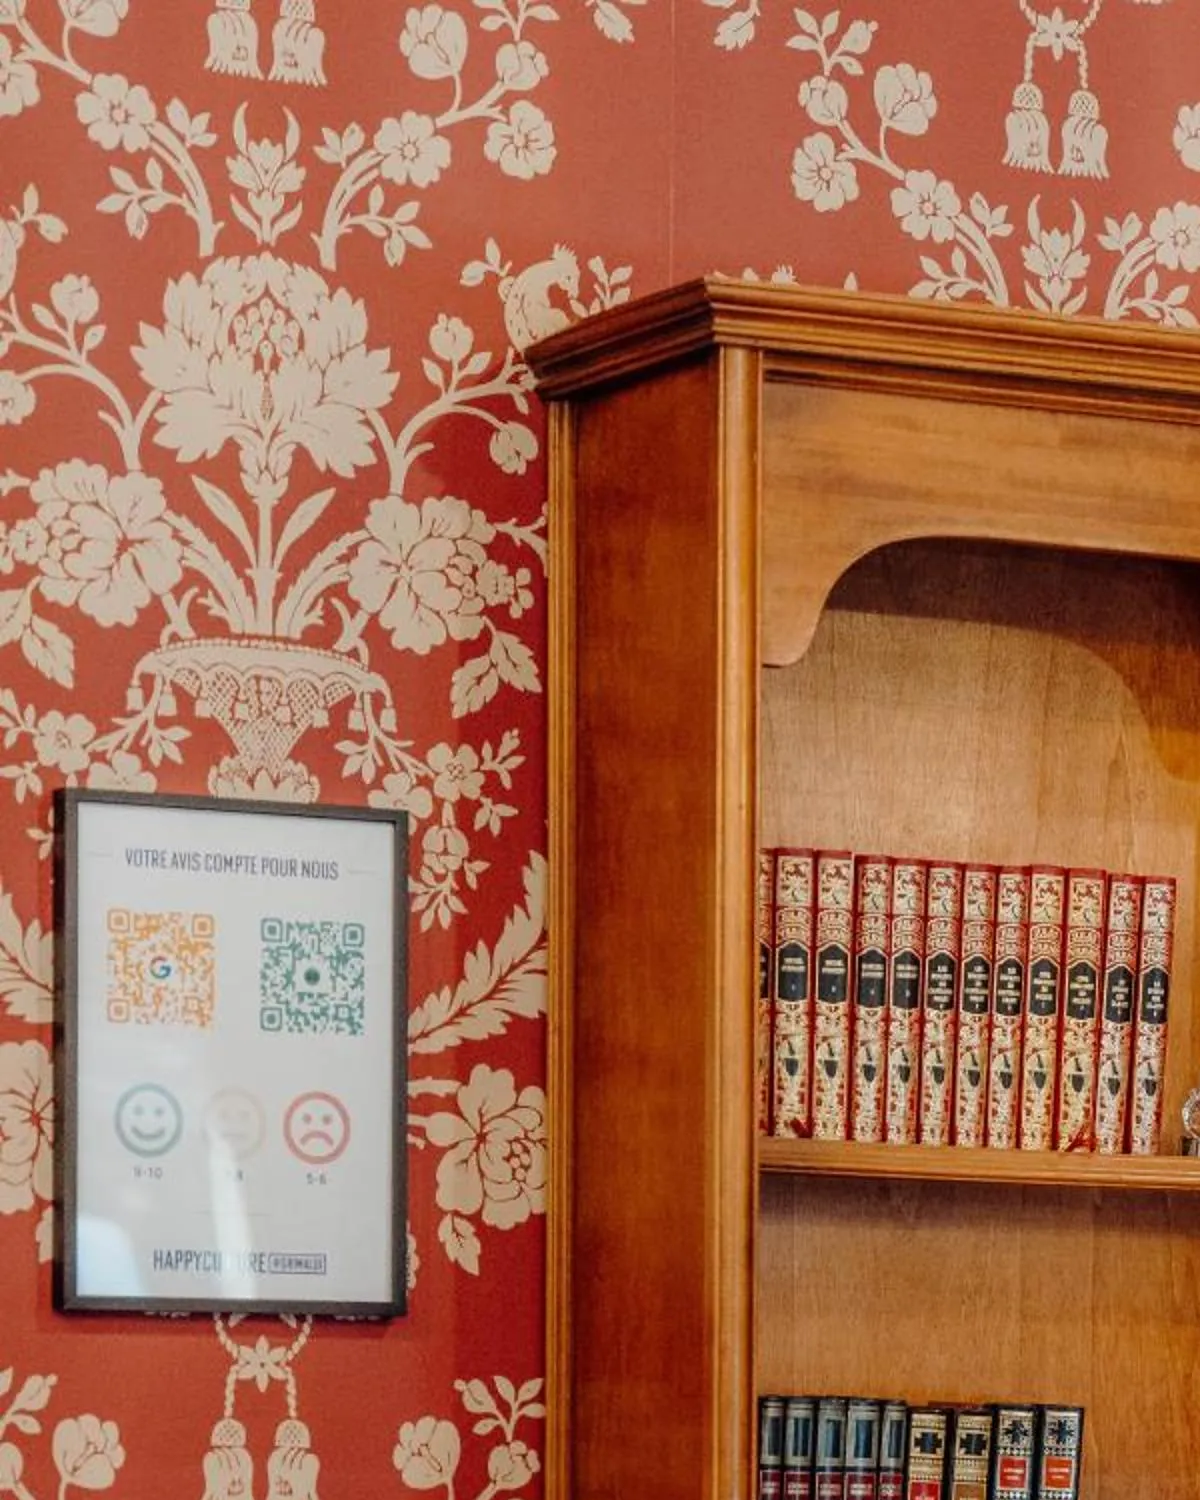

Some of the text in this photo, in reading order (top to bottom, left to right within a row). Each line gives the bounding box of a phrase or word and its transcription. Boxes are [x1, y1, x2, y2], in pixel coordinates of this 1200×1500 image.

[125, 848, 339, 881] VOTRE AVIS COMPTE POUR NOUS
[153, 1249, 266, 1274] HAPPYCURE
